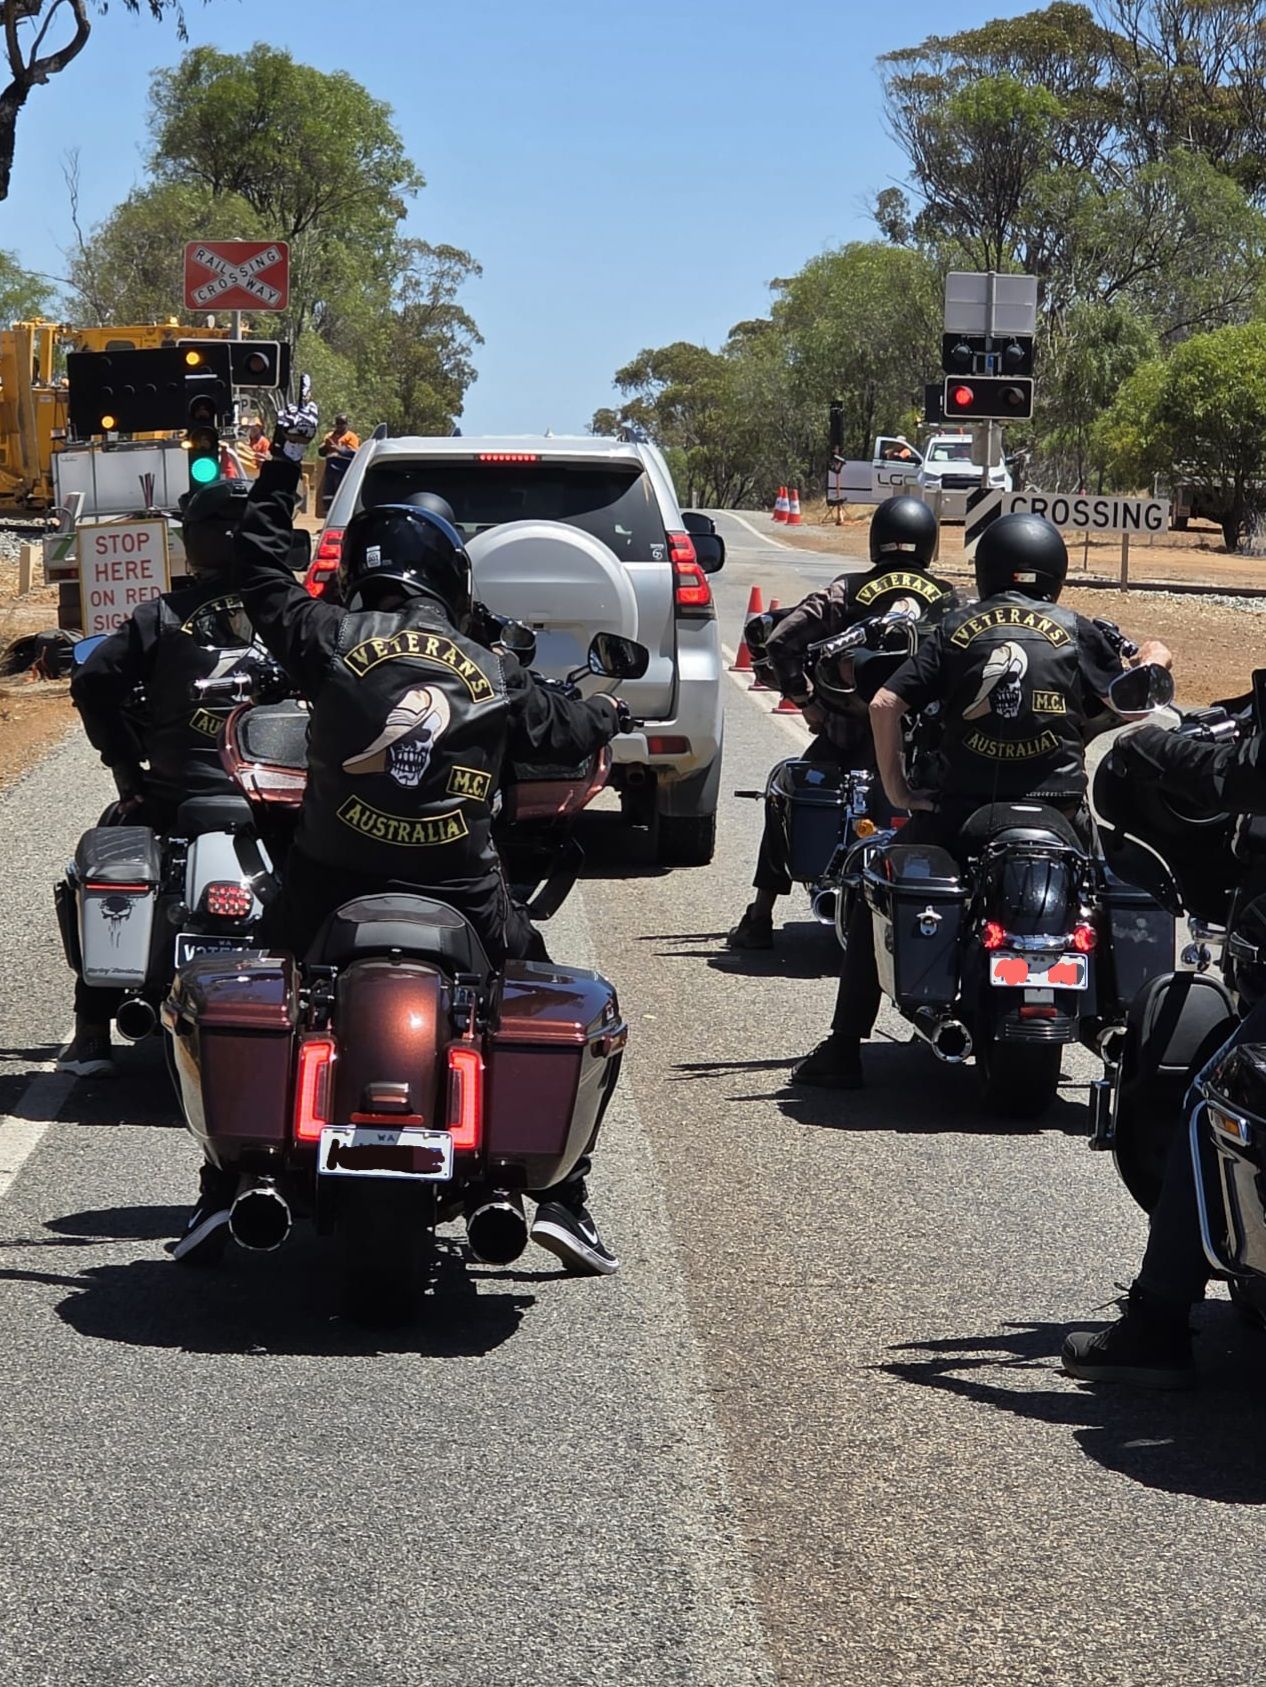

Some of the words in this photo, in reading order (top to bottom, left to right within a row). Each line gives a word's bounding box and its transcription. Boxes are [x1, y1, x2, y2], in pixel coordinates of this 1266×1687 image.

[197, 251, 276, 301] CROSSING
[1010, 496, 1163, 531] CROSSING
[95, 532, 150, 555] STOP
[95, 559, 153, 582] HERE
[90, 589, 115, 607] ON
[125, 586, 162, 605] RED
[861, 574, 938, 600] VETERAN
[93, 612, 133, 631] SIG
[957, 608, 1064, 641] VETERANS
[352, 633, 488, 693] VETERANS
[968, 733, 1051, 757] AUSTRALIA
[345, 803, 460, 843] AUSTRALIA
